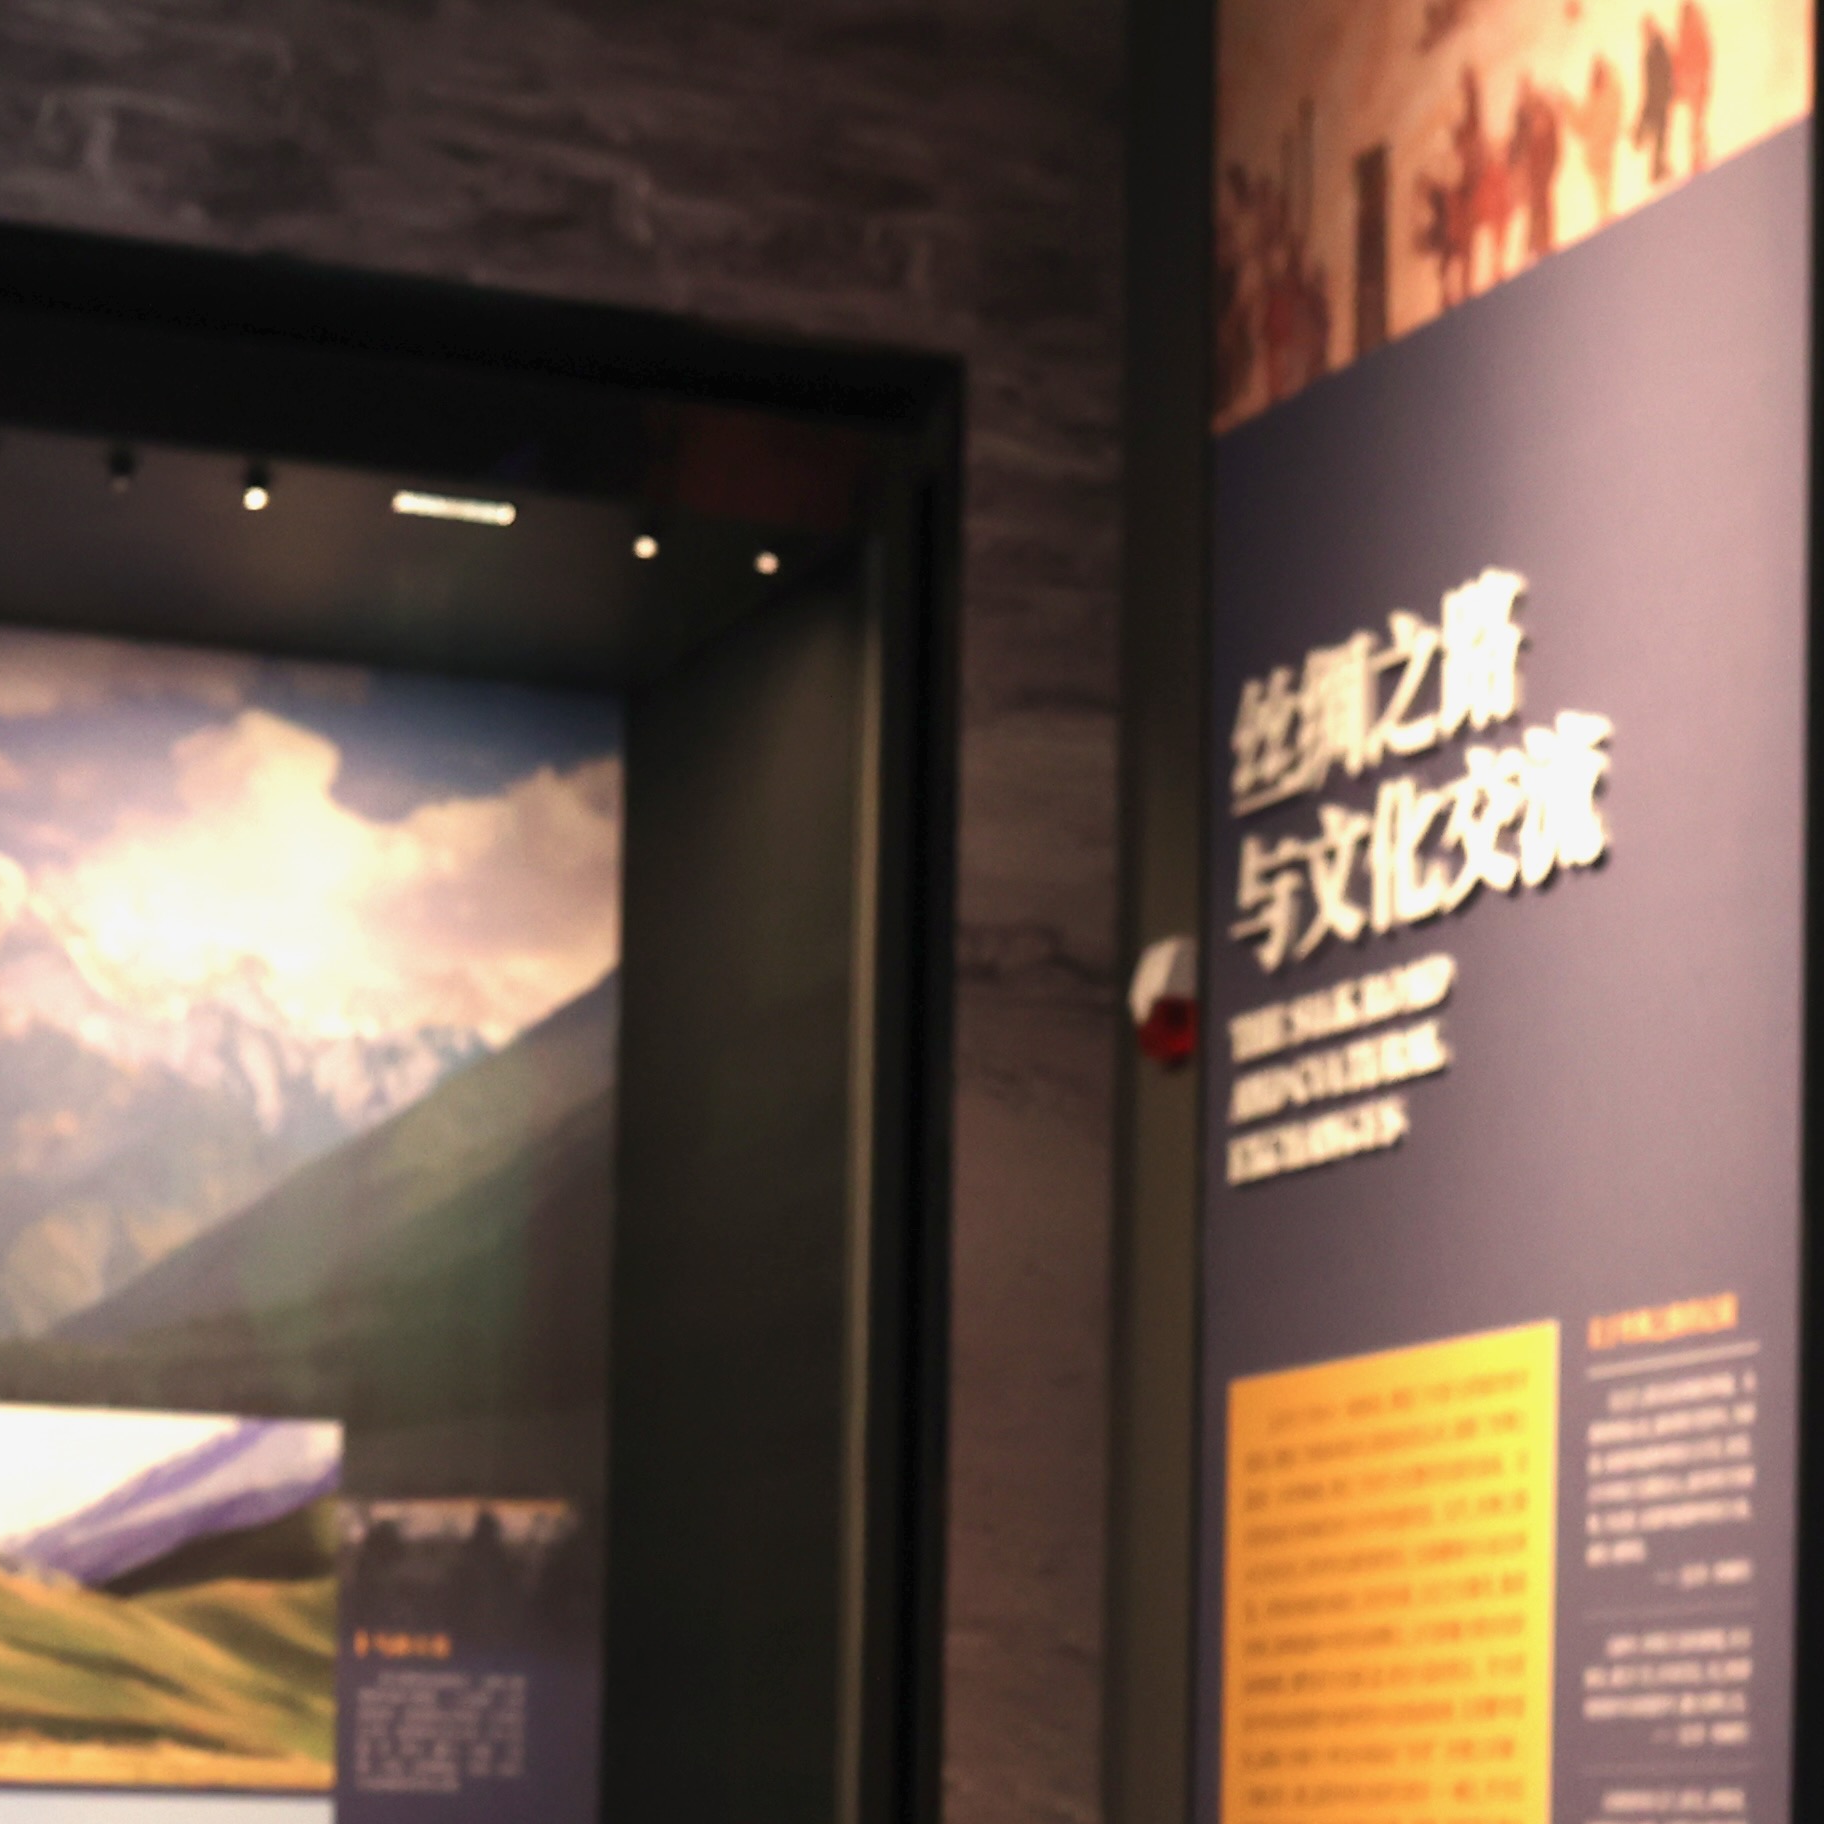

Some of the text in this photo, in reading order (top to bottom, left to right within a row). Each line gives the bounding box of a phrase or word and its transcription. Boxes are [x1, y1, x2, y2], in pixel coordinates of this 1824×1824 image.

[1229, 566, 1527, 817] 丝绸之路
[1228, 708, 1613, 970] 与文化交流
